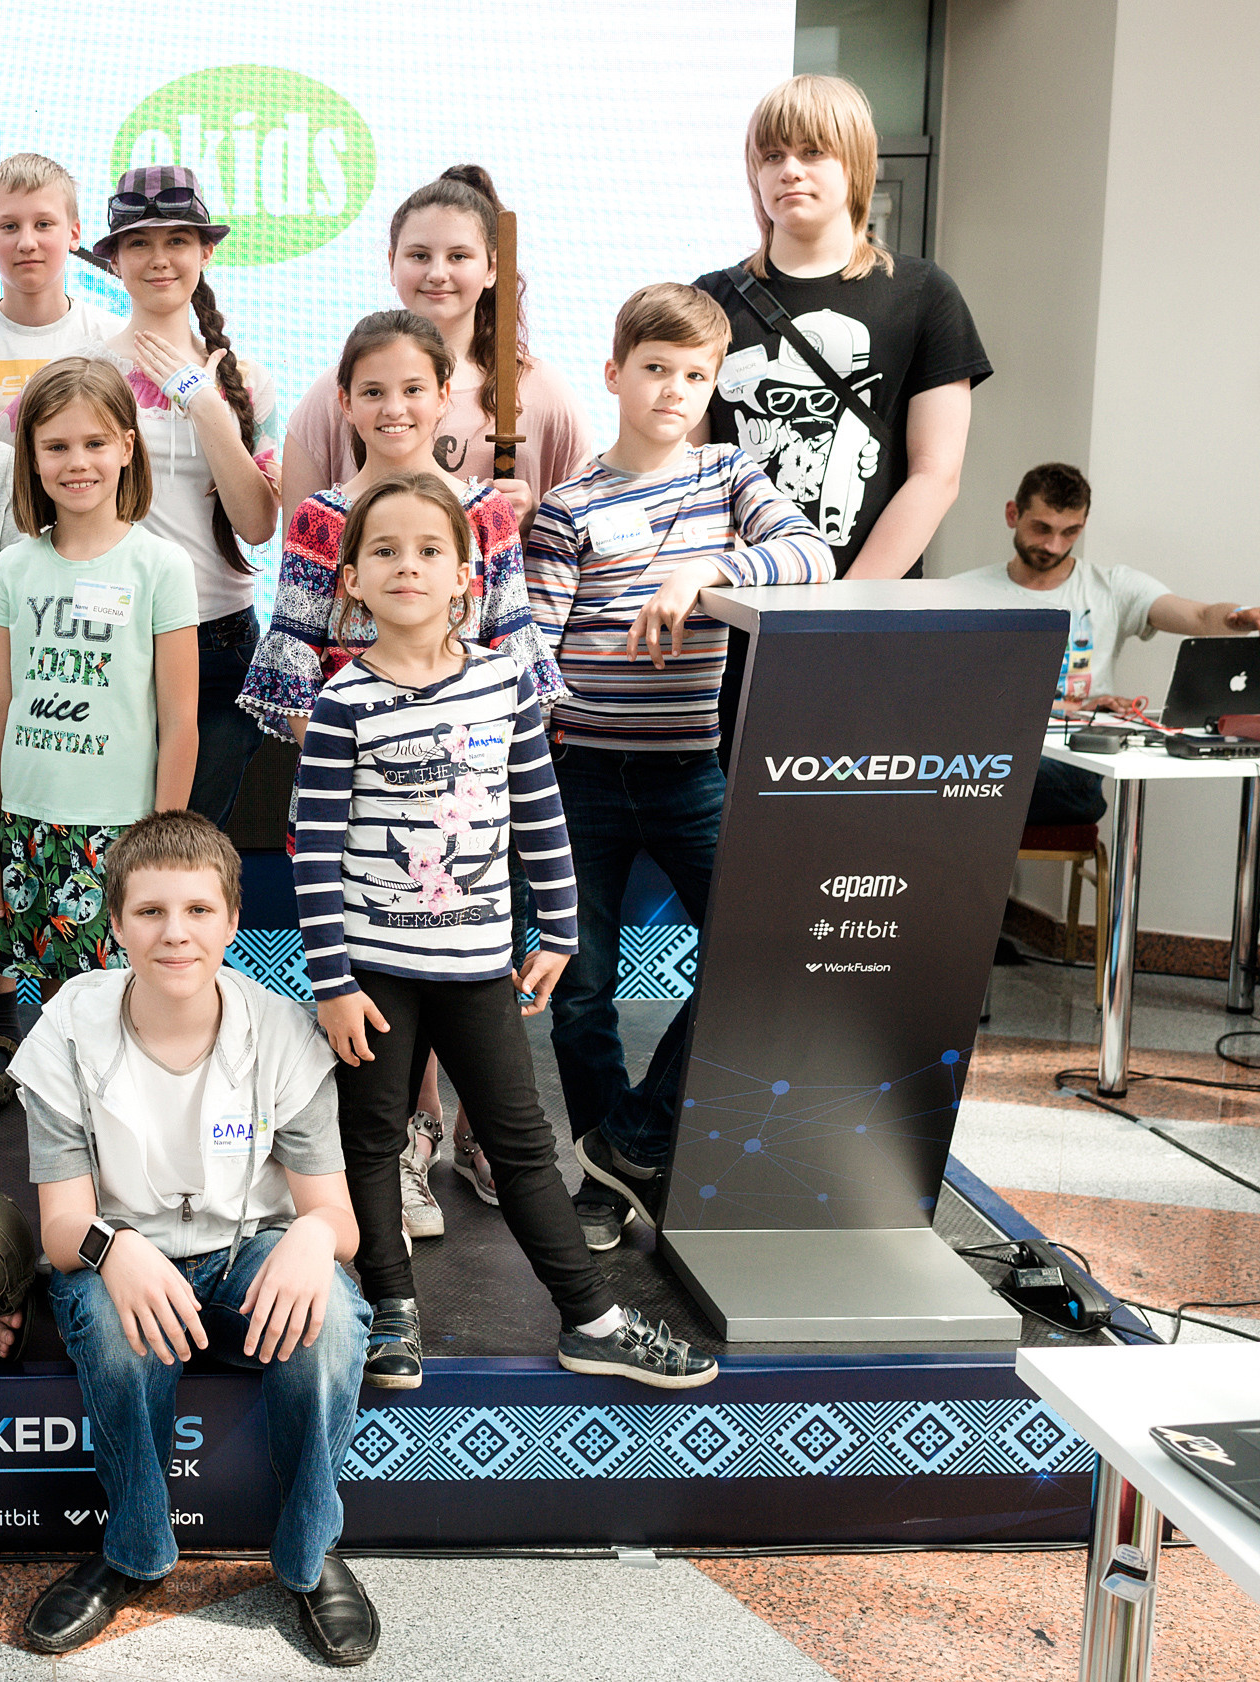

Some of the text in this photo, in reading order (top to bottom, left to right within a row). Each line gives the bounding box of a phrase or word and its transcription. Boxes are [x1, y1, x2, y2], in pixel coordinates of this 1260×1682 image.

[92, 605, 125, 617] EUGENIA
[30, 692, 90, 722] nice
[15, 724, 110, 756] EVERYDAY
[468, 752, 486, 760] Name
[385, 769, 410, 784] OF
[414, 762, 453, 783] THE
[942, 784, 1005, 798] MINSK
[387, 907, 482, 928] MEMORIES
[839, 919, 898, 939] fitbit
[824, 962, 891, 973] WorkFusion
